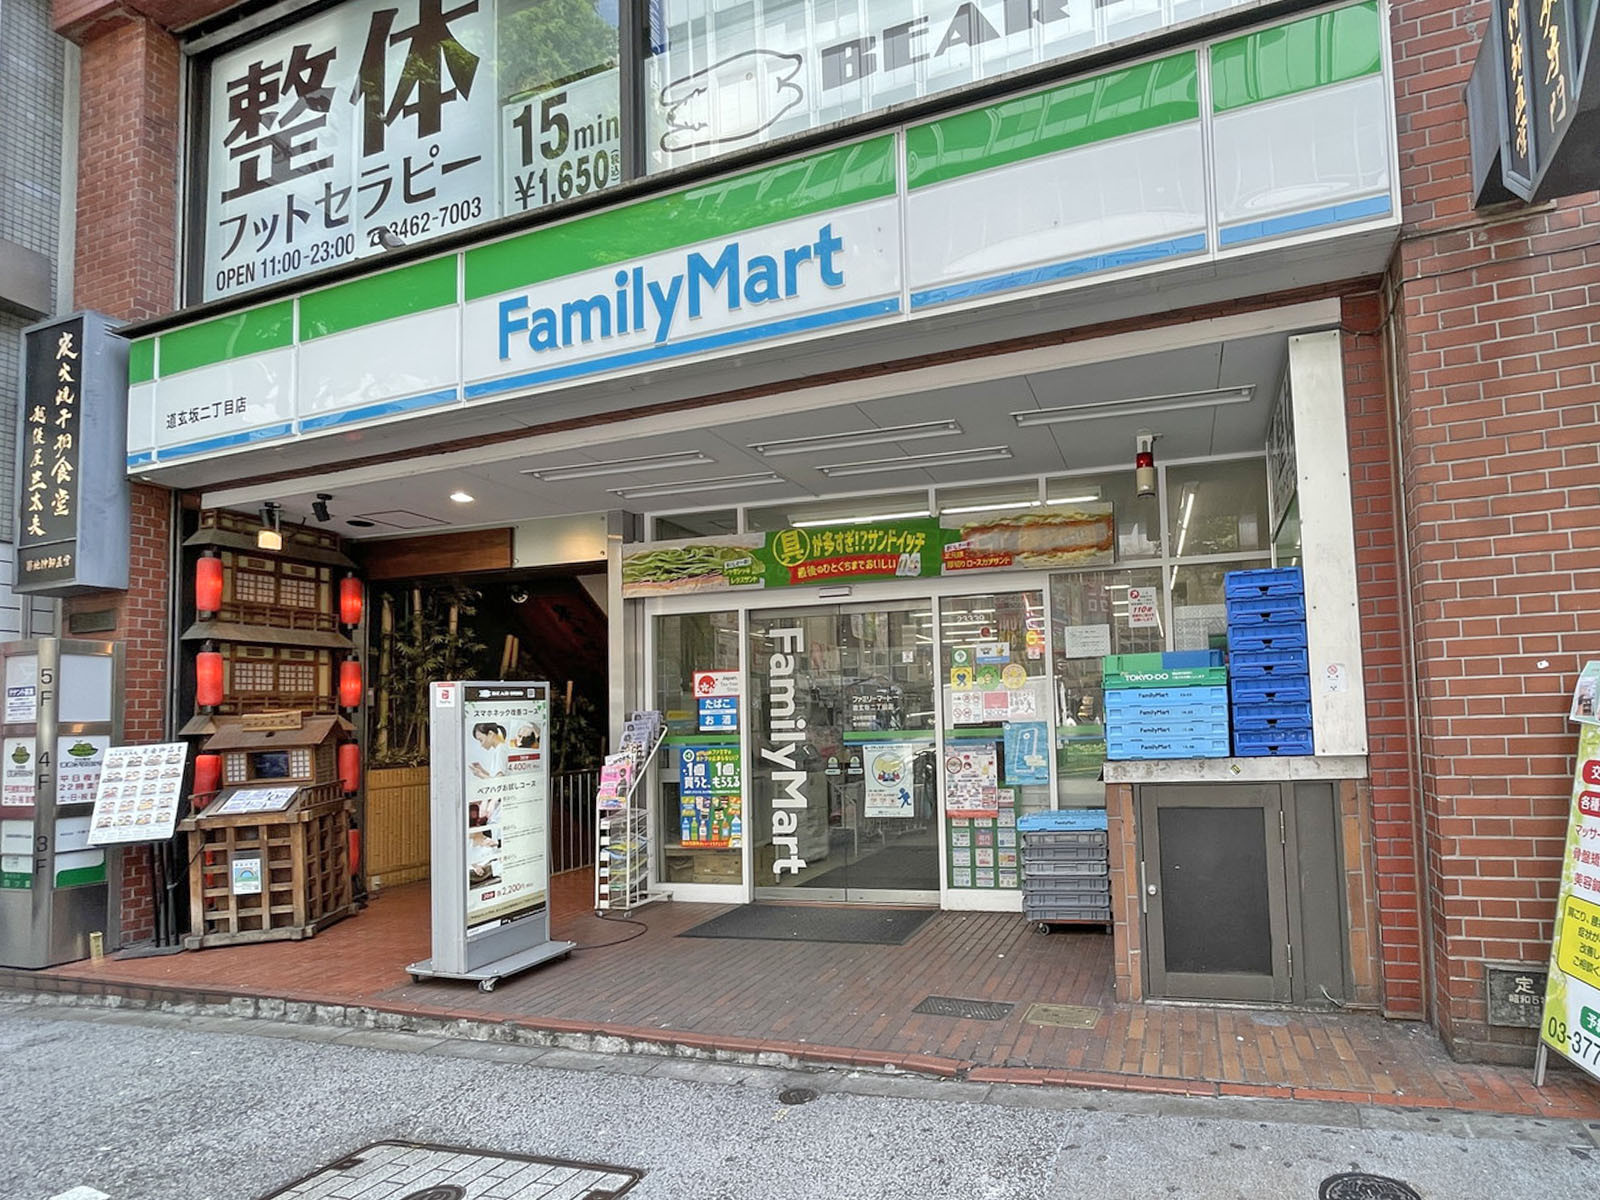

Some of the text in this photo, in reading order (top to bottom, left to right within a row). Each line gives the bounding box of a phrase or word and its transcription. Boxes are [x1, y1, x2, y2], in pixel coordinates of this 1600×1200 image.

[221, 0, 480, 204] 整体
[219, 144, 482, 261] フットセラピー
[216, 233, 355, 291] OPEN 11:00-23:00
[498, 223, 844, 361] FamilyMart
[166, 396, 247, 430] 道玄坂二丁目店
[797, 559, 897, 579] 最後のひとくちまでおいしい
[705, 699, 731, 709] たばこ
[687, 762, 735, 776] 1個 1個
[761, 627, 807, 875] FamilyMart
[684, 776, 740, 789] 買うと、 もらえる
